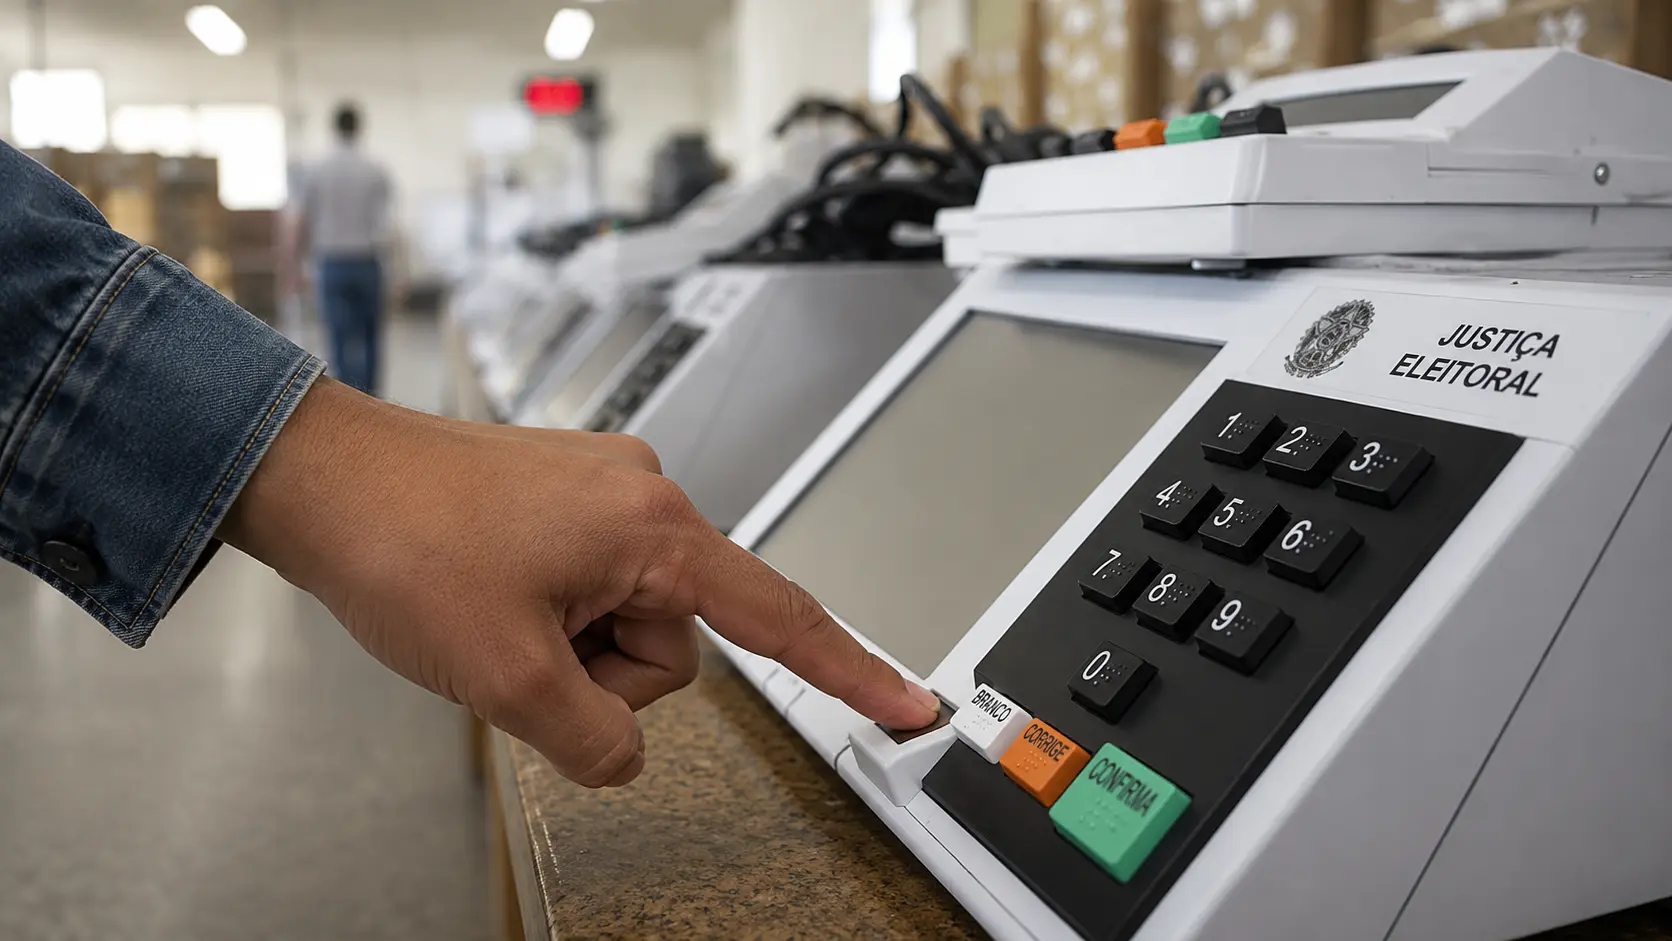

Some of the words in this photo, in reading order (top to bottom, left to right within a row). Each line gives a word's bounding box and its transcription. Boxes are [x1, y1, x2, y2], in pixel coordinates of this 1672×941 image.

[1438, 324, 1561, 361] JUSTIÇA
[1389, 353, 1544, 398] ELEITORAL
[1218, 412, 1242, 438] 1
[1275, 426, 1308, 454] 2
[1349, 441, 1381, 471] 3
[1155, 480, 1182, 507] 4
[1213, 497, 1244, 527] 5
[1281, 519, 1312, 550] 6
[1092, 549, 1122, 576] 7
[1148, 573, 1177, 602] 8
[1211, 599, 1242, 631] 9
[1082, 650, 1111, 681] 0
[971, 689, 1012, 722] BRANCO
[1023, 723, 1070, 762] CORRIGE
[1088, 757, 1158, 817] CONFIRMA
